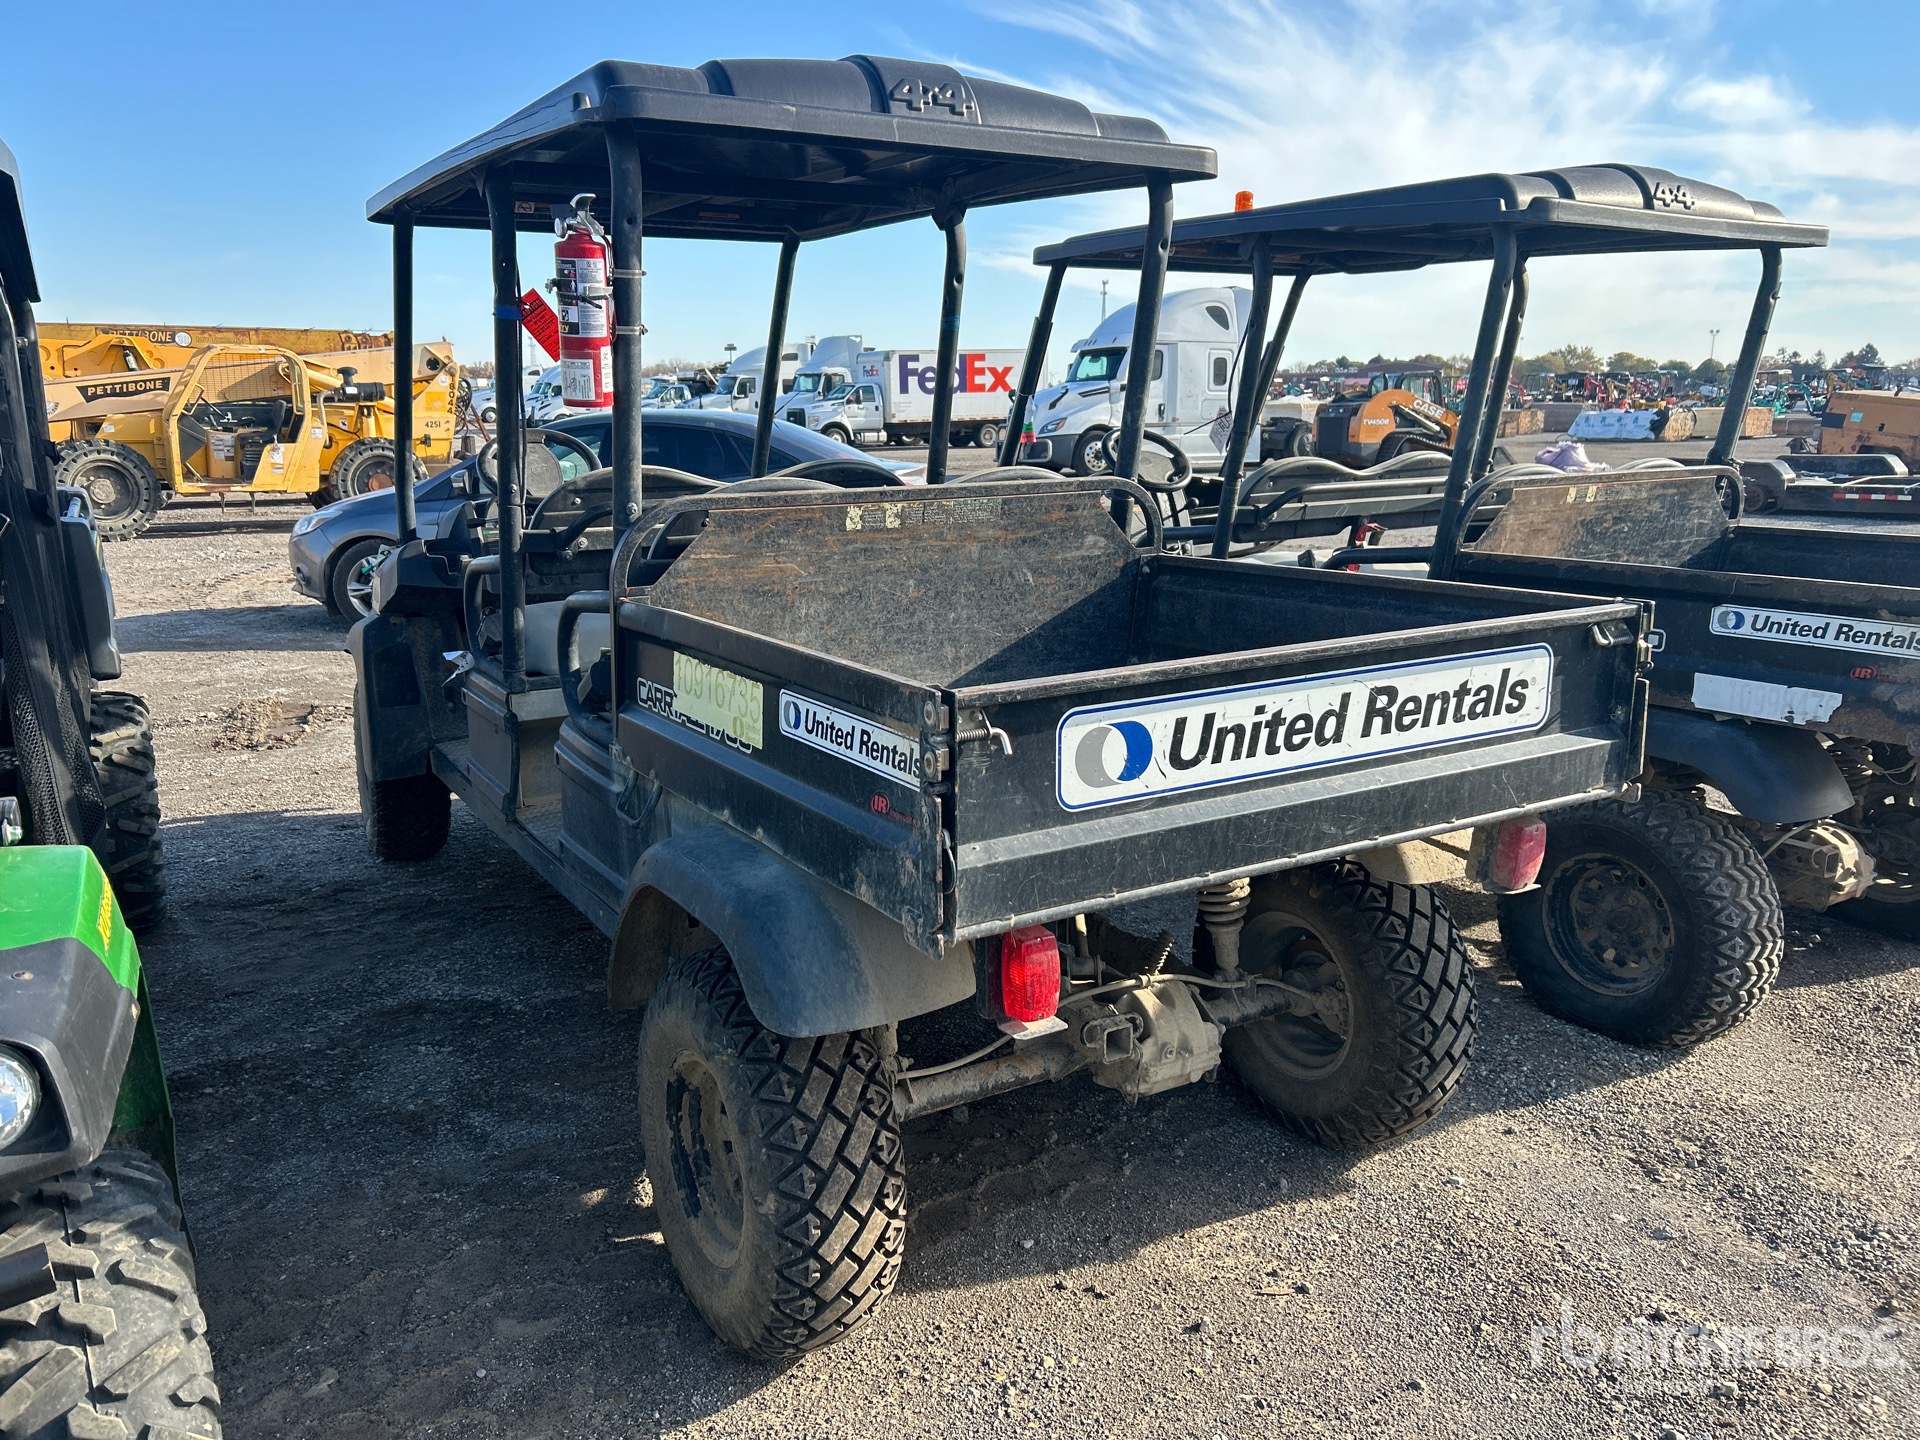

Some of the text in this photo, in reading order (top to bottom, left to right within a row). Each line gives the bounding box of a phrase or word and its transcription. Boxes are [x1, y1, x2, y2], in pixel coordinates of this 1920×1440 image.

[87, 379, 163, 396] PETTIBONE
[862, 365, 880, 378] FedEx
[898, 353, 1014, 395] FedEx
[1412, 399, 1445, 420] CASE
[1750, 614, 1920, 651] United Rentals
[637, 677, 706, 734] CARR
[675, 654, 762, 724] 10916735
[1168, 667, 1530, 772] United Rentals
[804, 707, 856, 752] United
[858, 727, 921, 780] Rentals
[873, 794, 887, 814] IR
